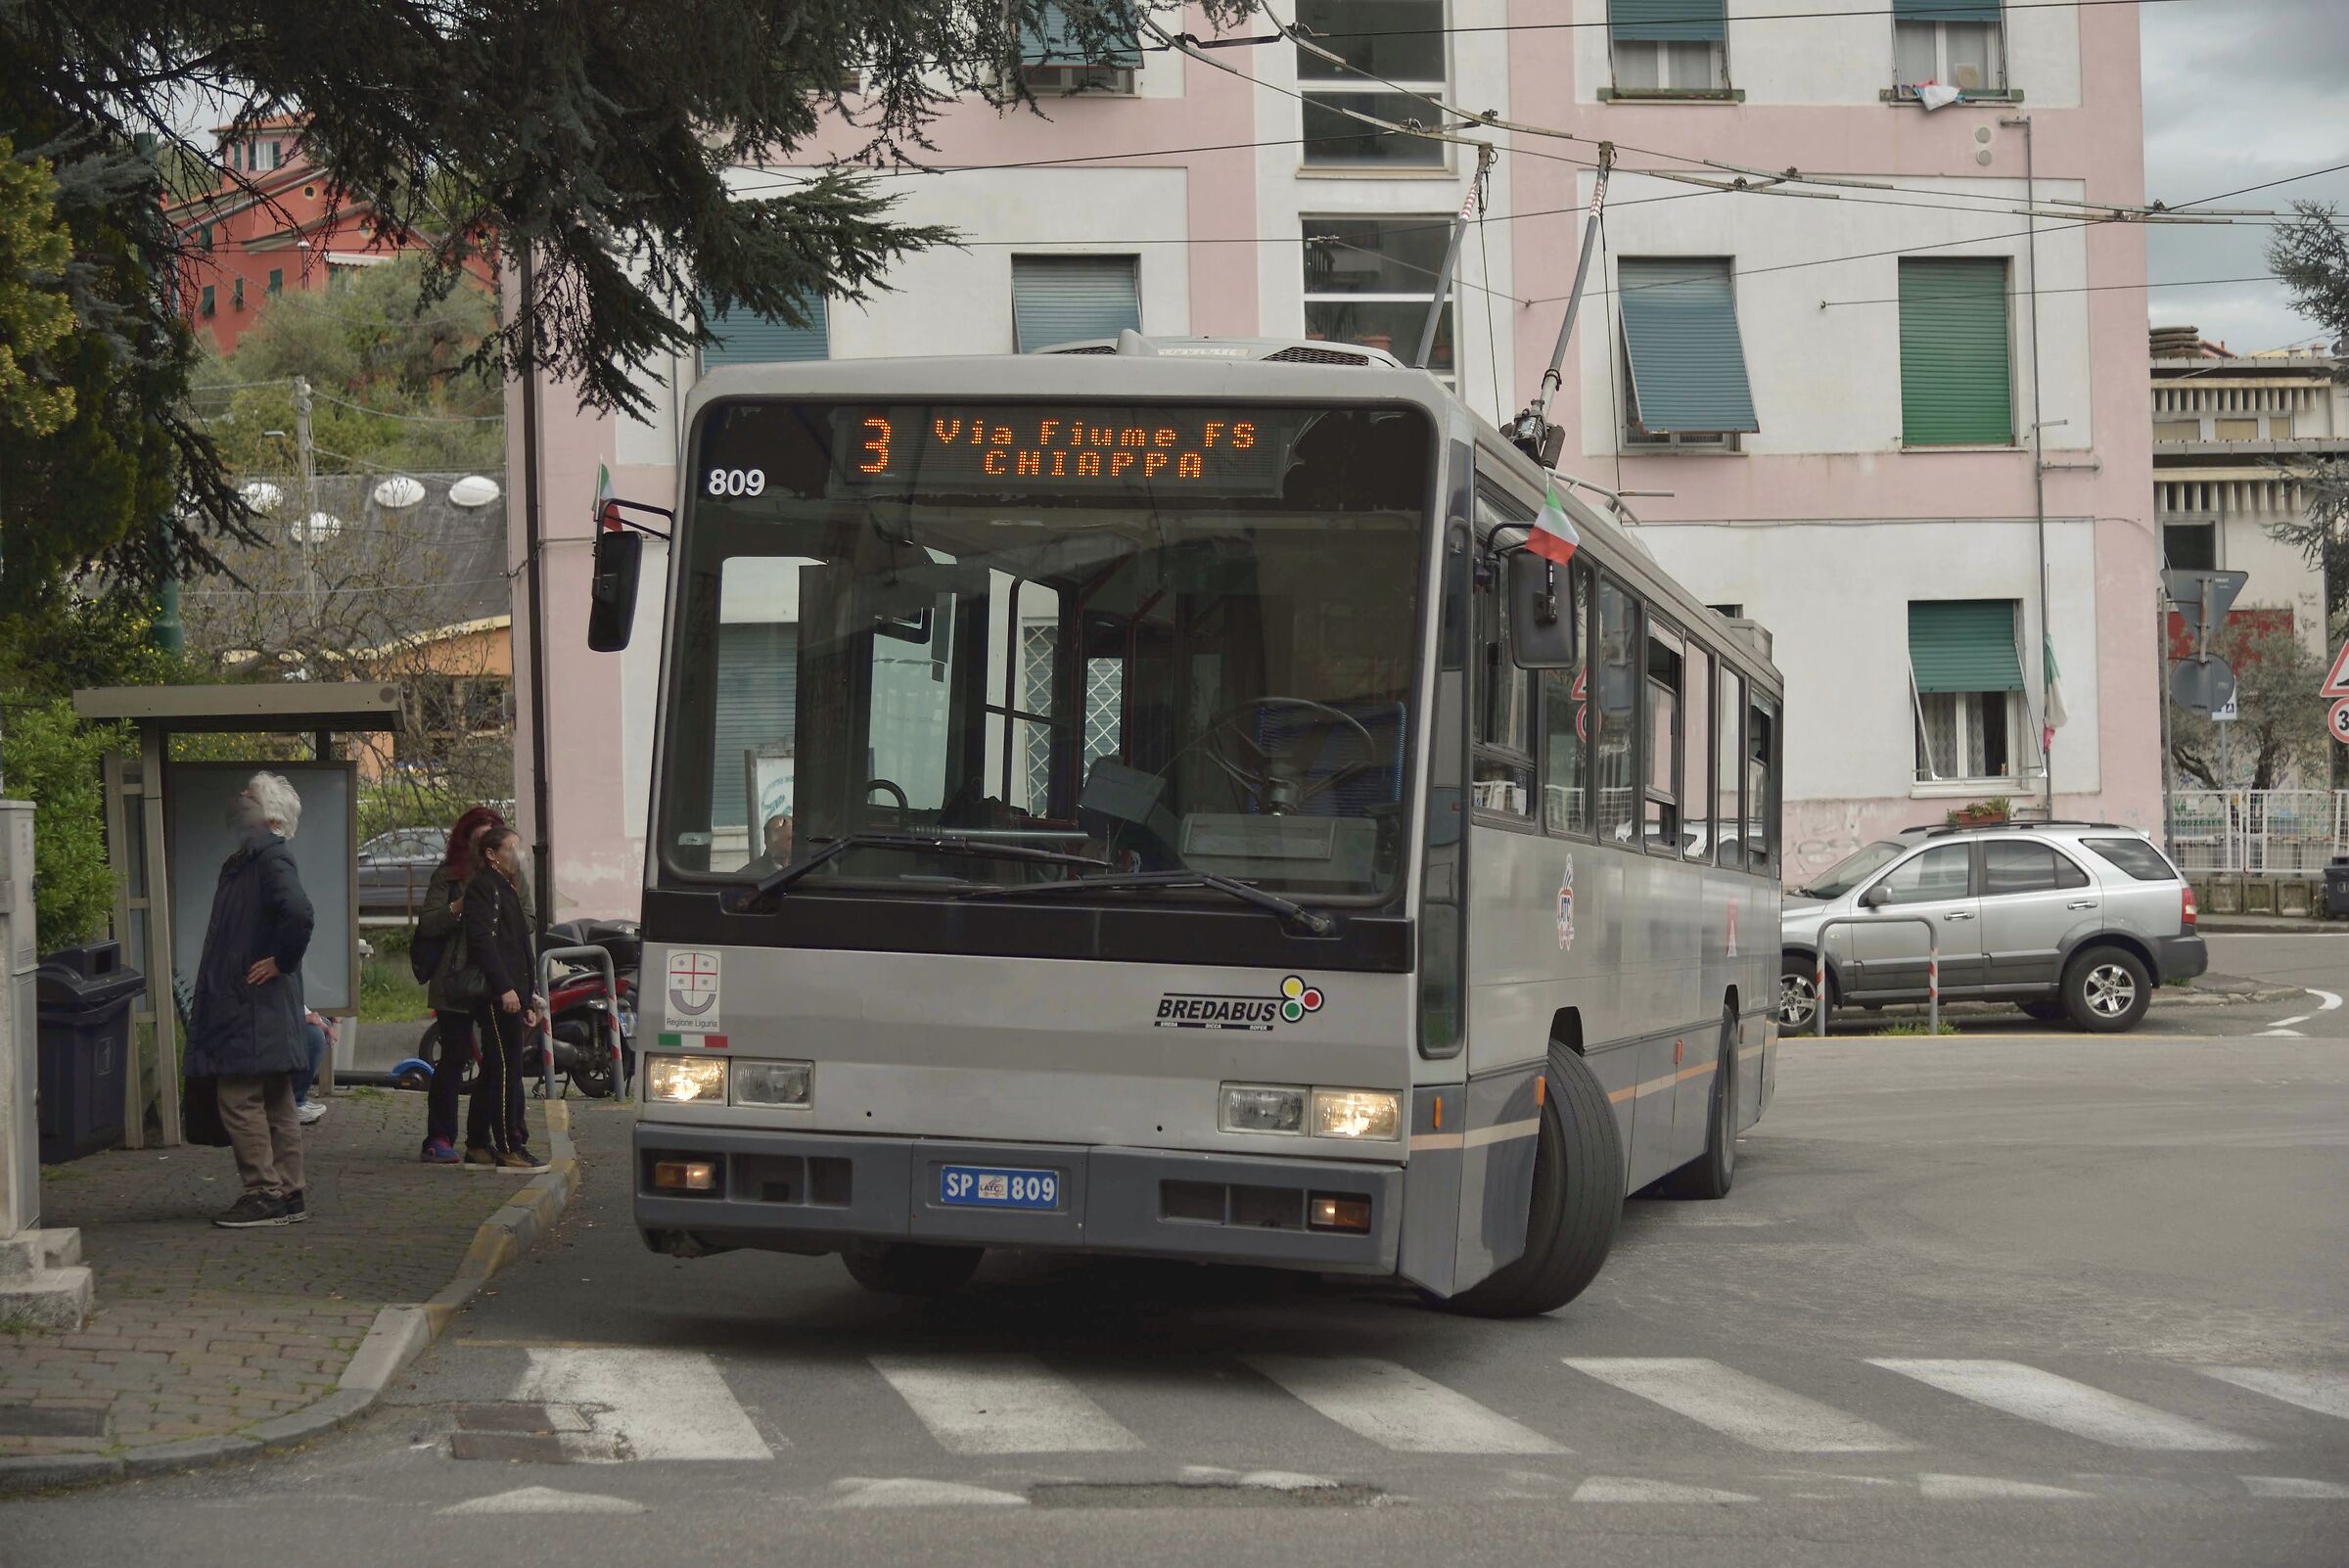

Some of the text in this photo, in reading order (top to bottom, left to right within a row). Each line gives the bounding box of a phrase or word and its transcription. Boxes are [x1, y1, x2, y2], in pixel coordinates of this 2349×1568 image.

[860, 419, 892, 475] 3
[935, 420, 1256, 449] Via Fiume FS
[984, 450, 1203, 478] CHIAPPA
[709, 469, 765, 496] 809
[667, 1018, 717, 1029] Regione Liguria
[1157, 999, 1276, 1022] BREDABUS
[946, 1173, 1055, 1201] SP 809
